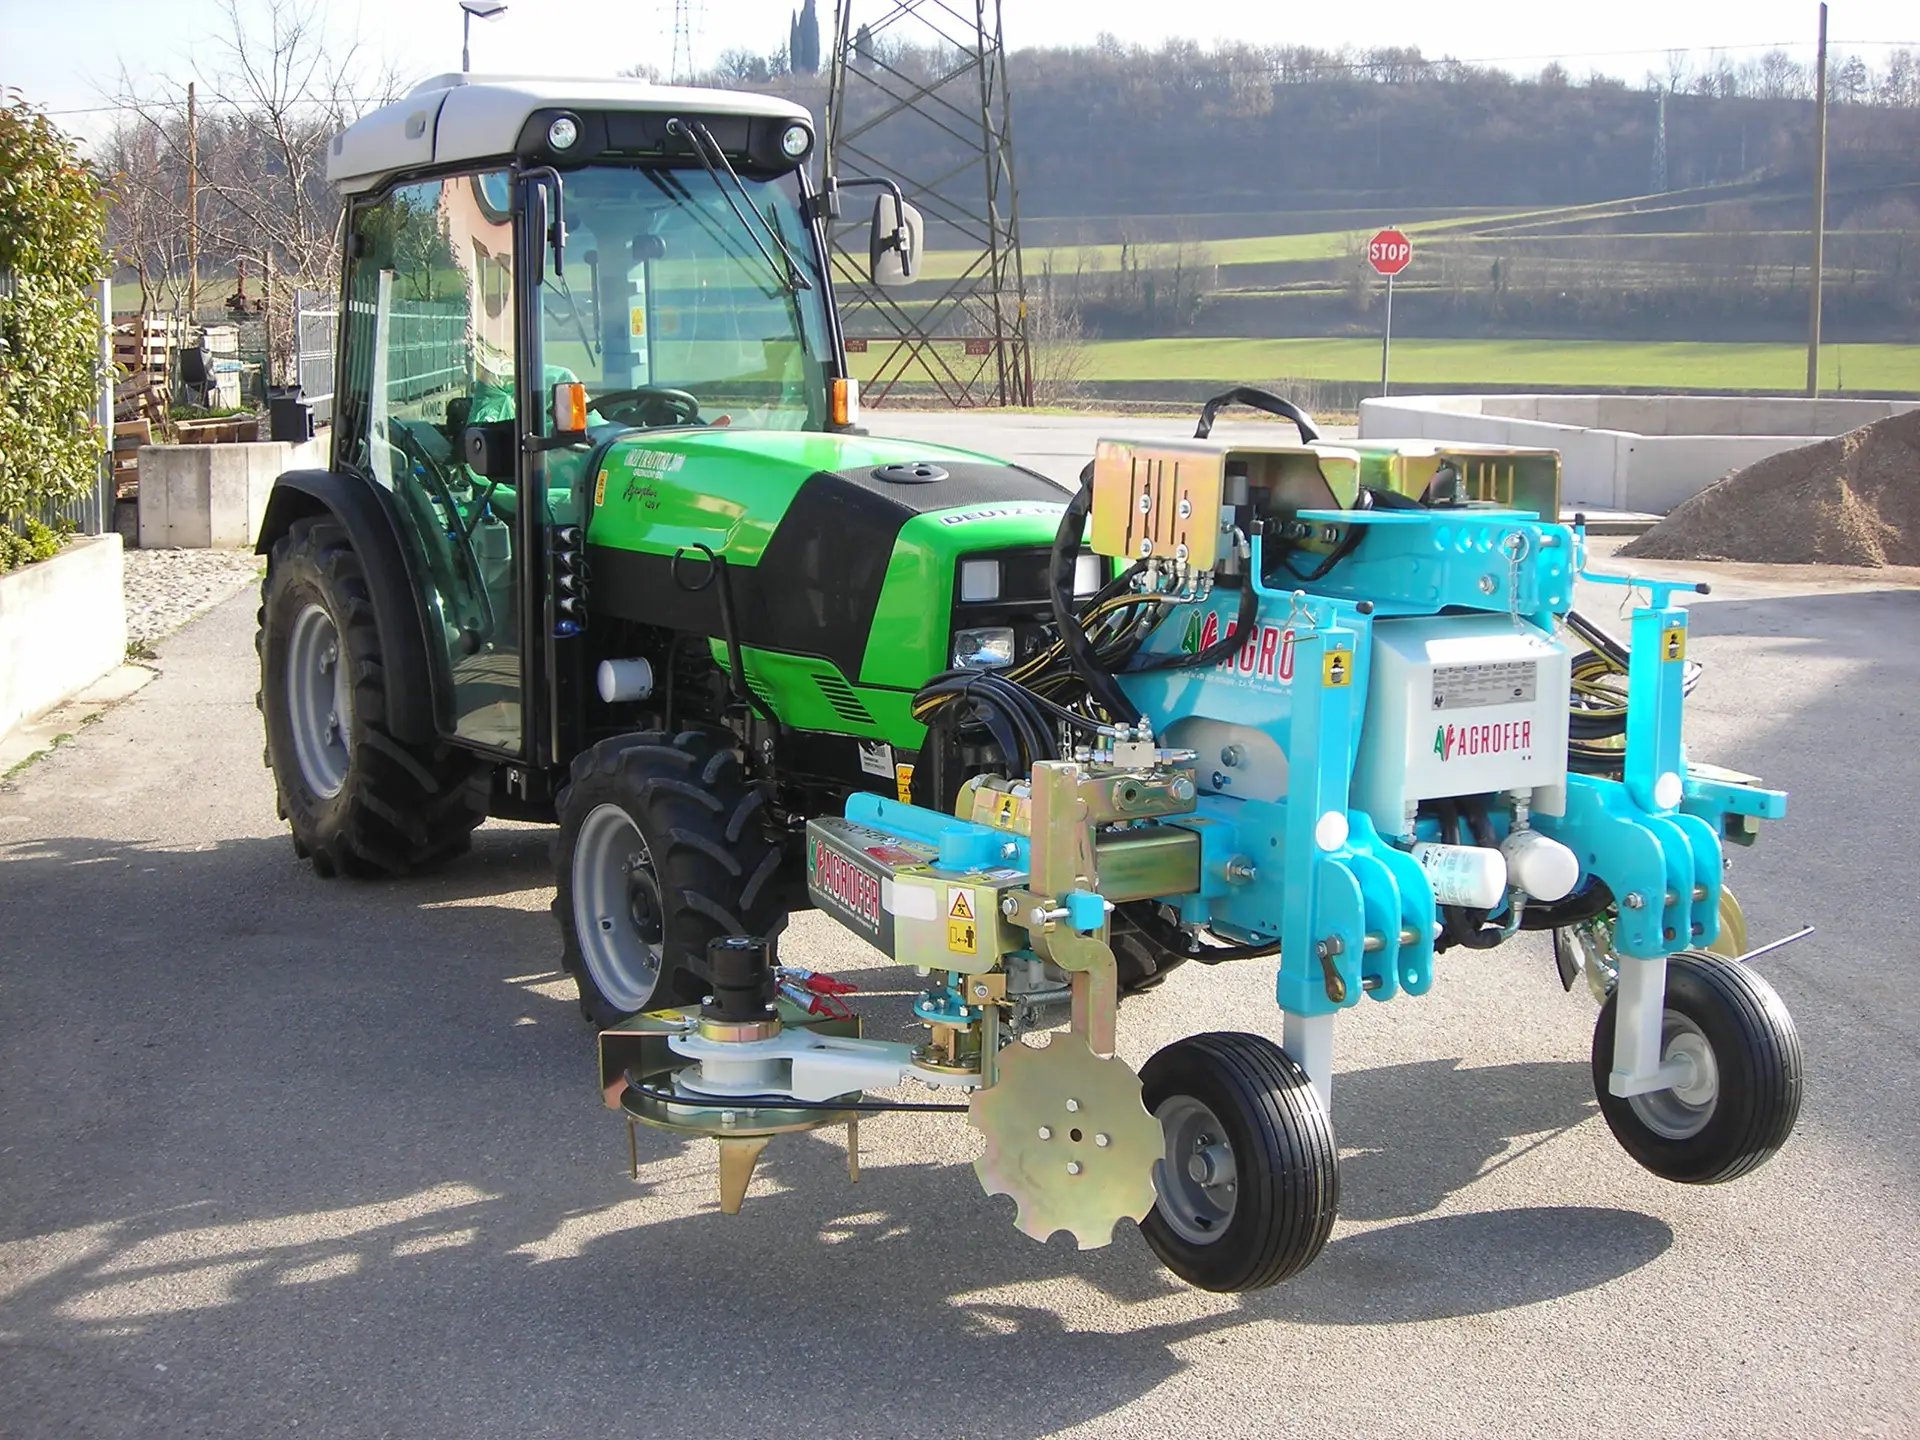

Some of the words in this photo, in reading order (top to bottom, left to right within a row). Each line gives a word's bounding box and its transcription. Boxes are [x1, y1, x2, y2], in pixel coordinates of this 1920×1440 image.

[1371, 243, 1408, 261] STOP
[1457, 720, 1531, 756] AGROFER
[823, 849, 880, 923] AGROFER
